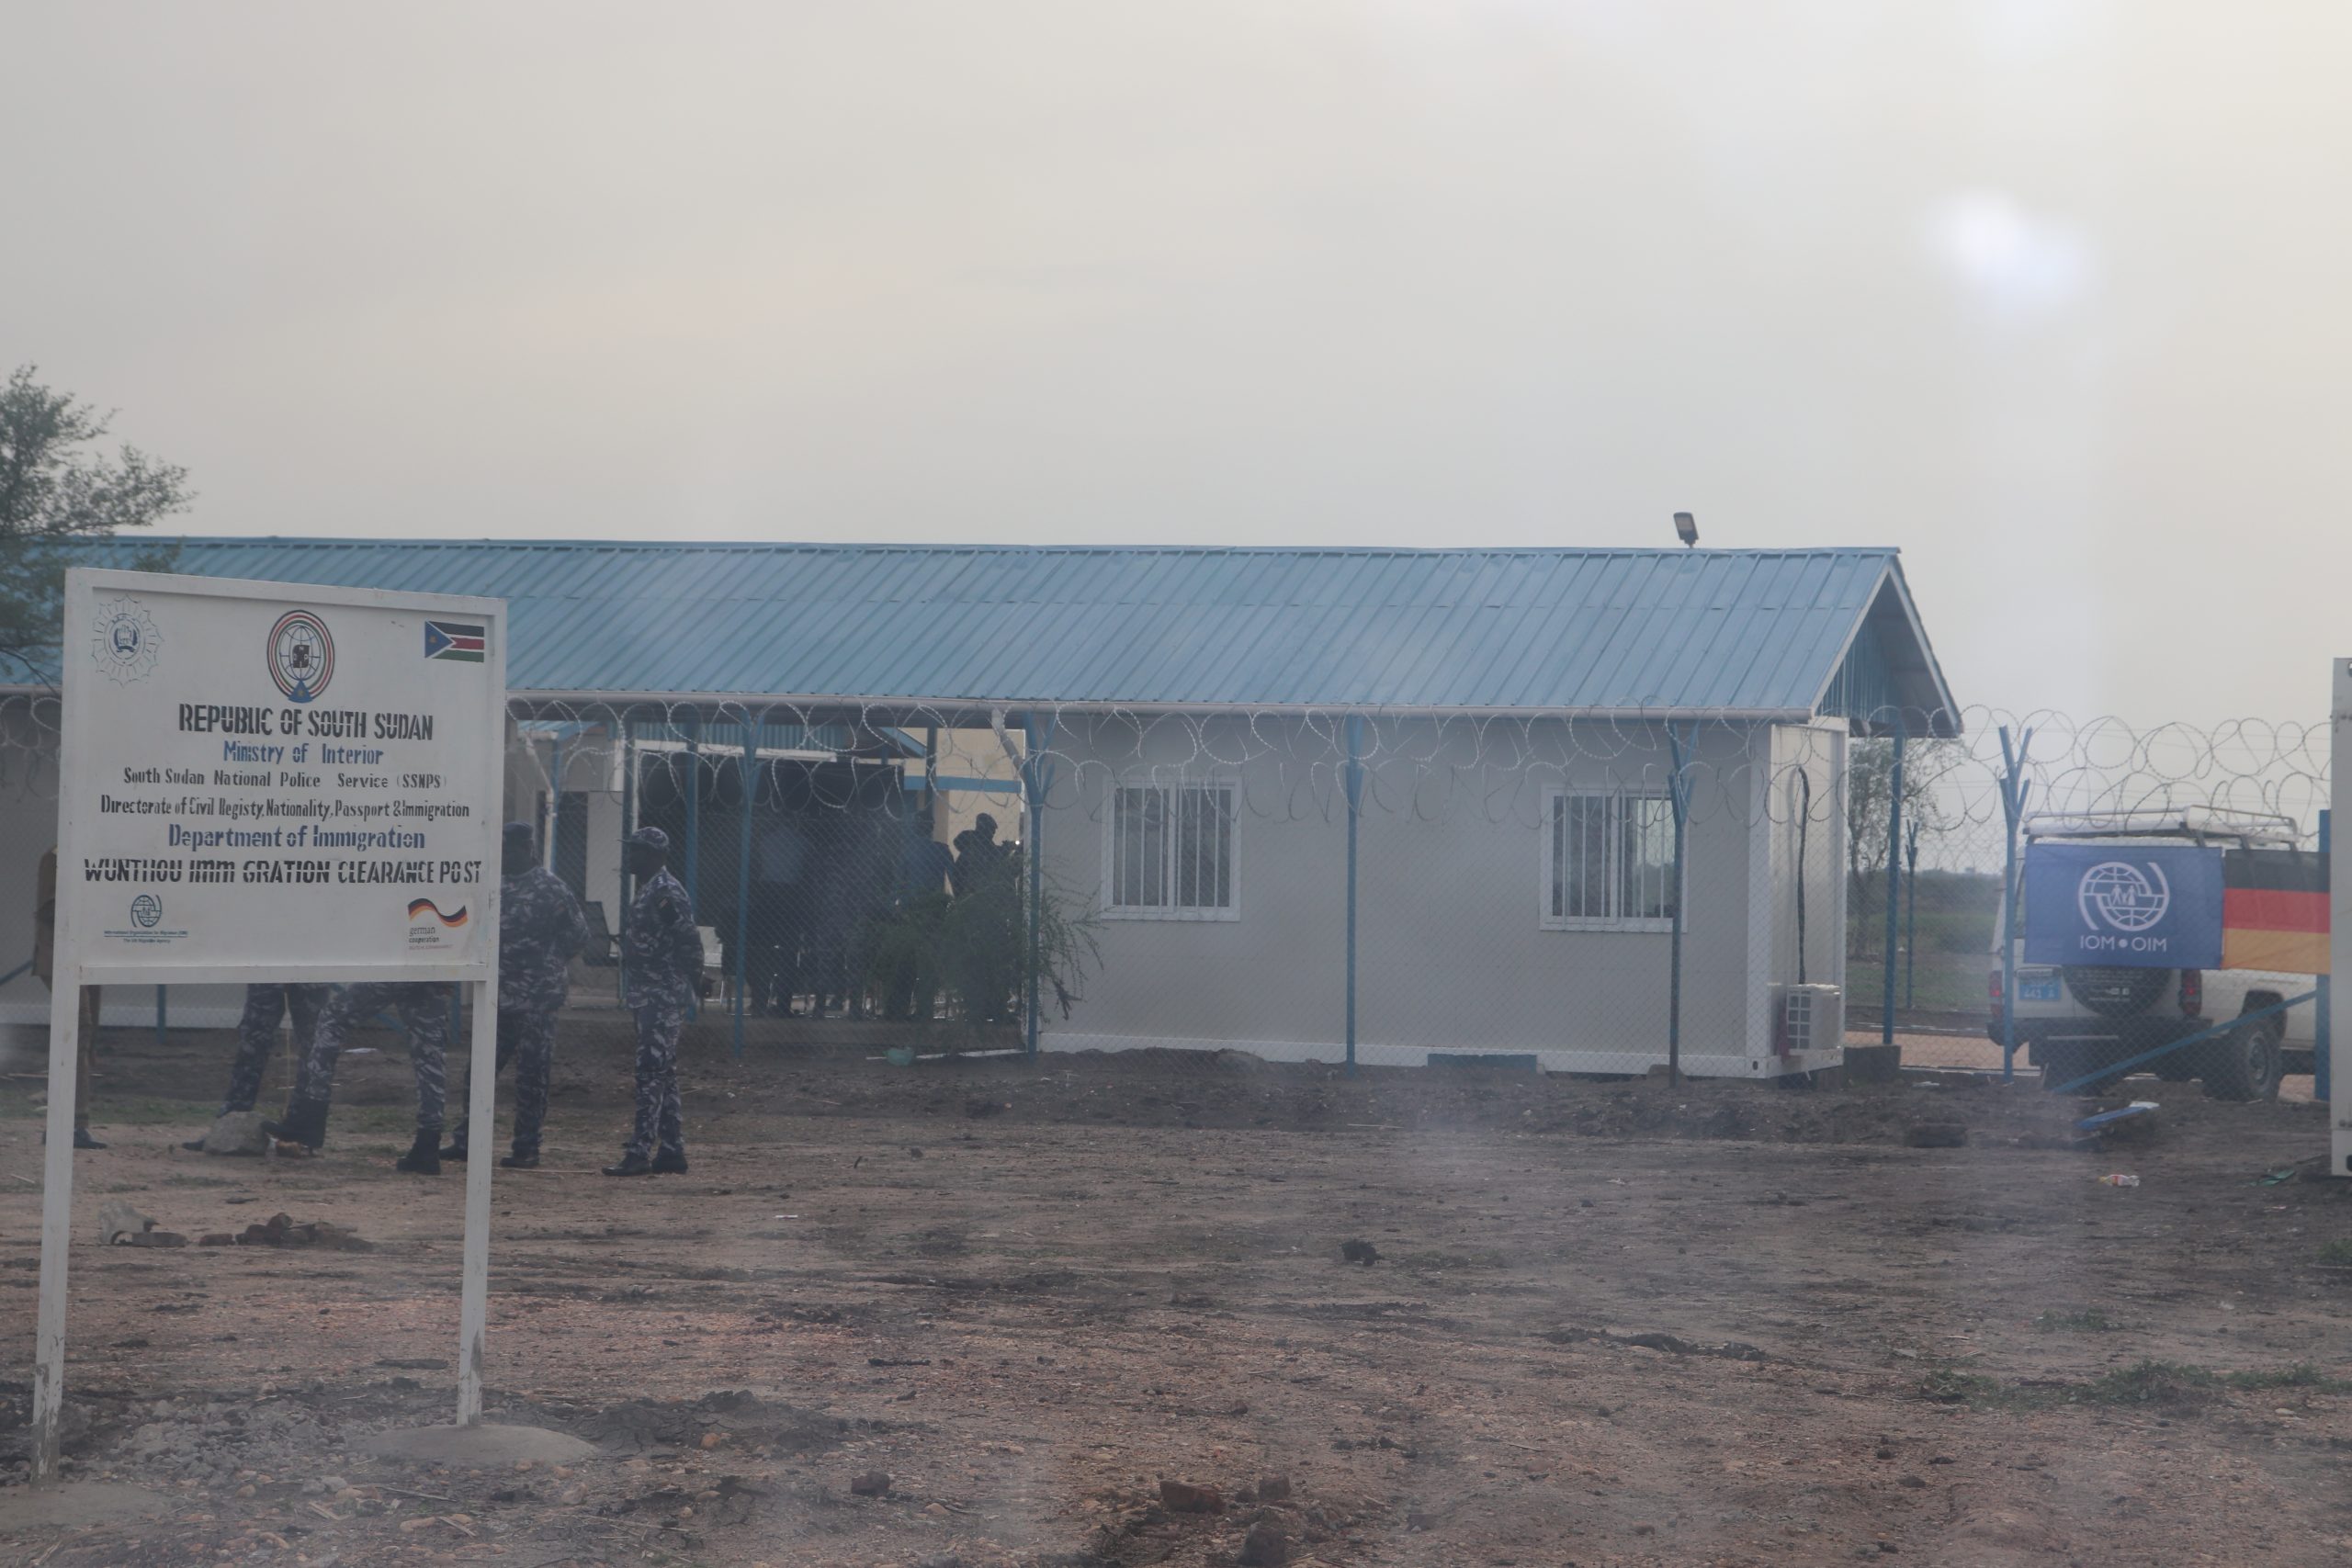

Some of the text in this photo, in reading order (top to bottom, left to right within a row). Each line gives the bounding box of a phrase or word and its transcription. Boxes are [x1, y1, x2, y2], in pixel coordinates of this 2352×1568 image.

[179, 704, 433, 740] REPUBLIC OF SOUTH SUDAN
[223, 740, 384, 764] Ministry of Interior
[123, 767, 160, 784] South
[165, 769, 205, 784] Sudan
[214, 770, 270, 786] National
[280, 772, 321, 788] Police
[337, 773, 389, 788] Service
[101, 795, 171, 814] Directorate
[175, 796, 187, 815] of
[189, 797, 214, 816] Civil
[335, 799, 390, 822] Passport
[169, 823, 425, 852] Department of Immigration
[338, 860, 435, 884] CLEARANCE
[2079, 935, 2168, 953] IOM OIM
